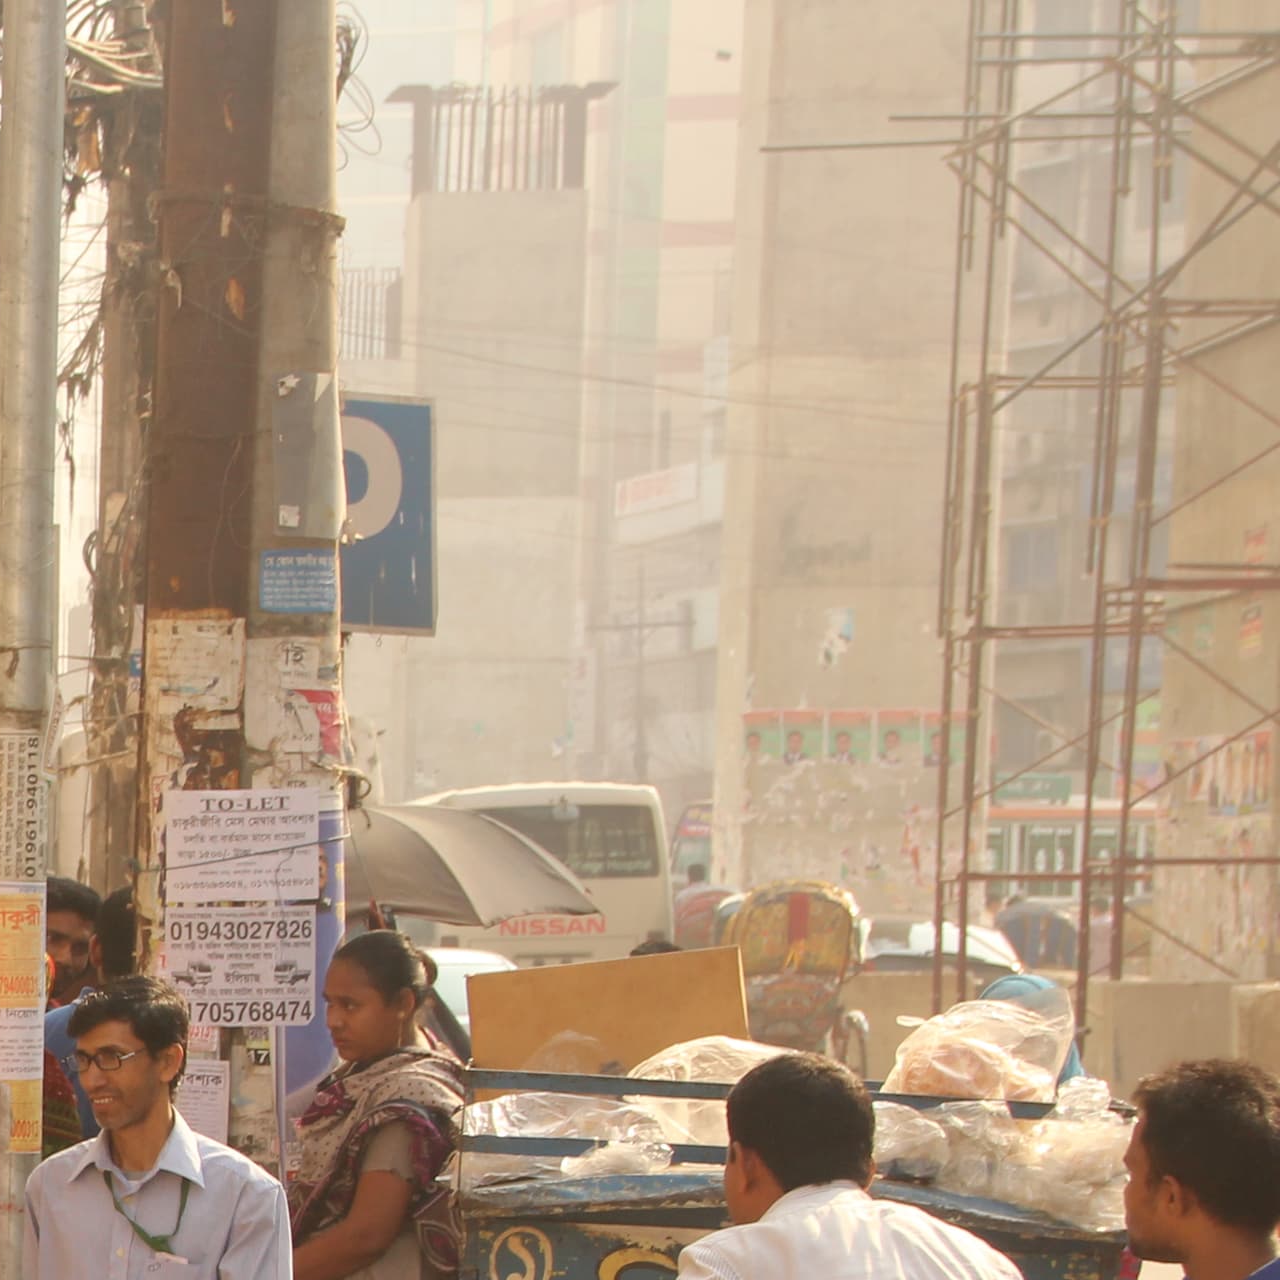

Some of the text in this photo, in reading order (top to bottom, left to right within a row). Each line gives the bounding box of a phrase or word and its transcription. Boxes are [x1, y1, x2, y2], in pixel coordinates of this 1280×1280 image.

[24, 736, 39, 877] 01961-940118
[200, 795, 290, 812] TO-LET
[170, 920, 312, 940] 01943027826
[500, 914, 607, 936] NISSAN
[188, 1000, 312, 1023] 1705768474
